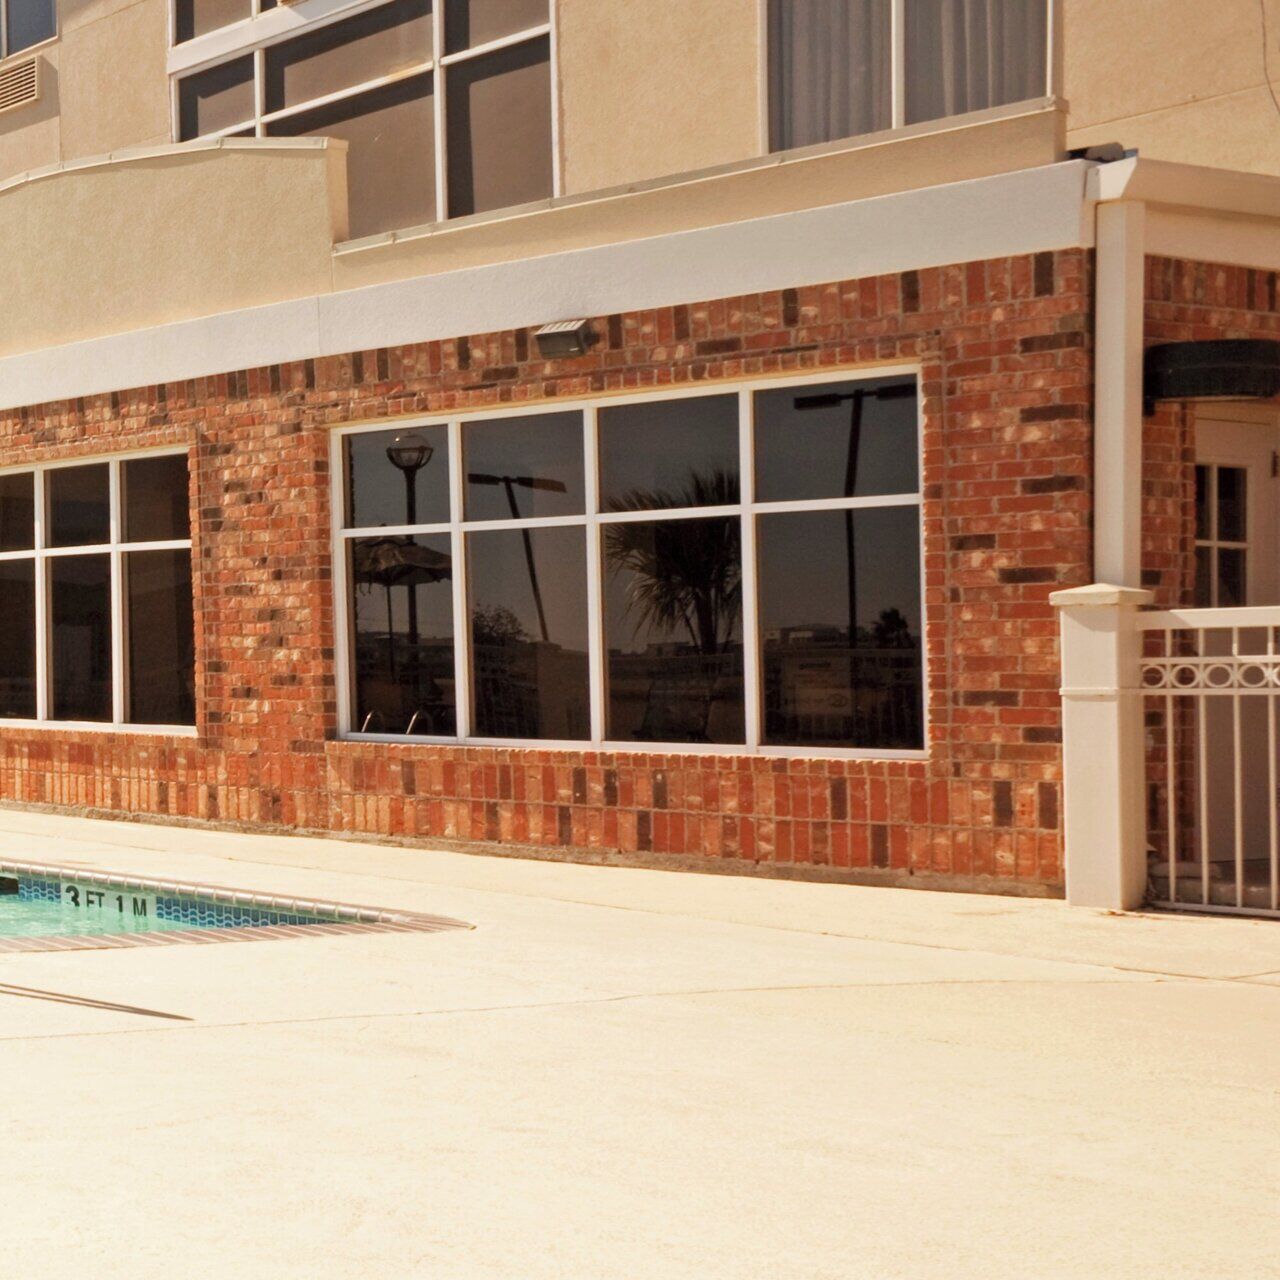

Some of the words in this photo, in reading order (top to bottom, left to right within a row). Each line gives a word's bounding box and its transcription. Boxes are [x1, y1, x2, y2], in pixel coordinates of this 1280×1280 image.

[65, 885, 80, 907] 3
[86, 890, 105, 908] FT
[116, 895, 123, 912] 1
[132, 897, 148, 917] M
